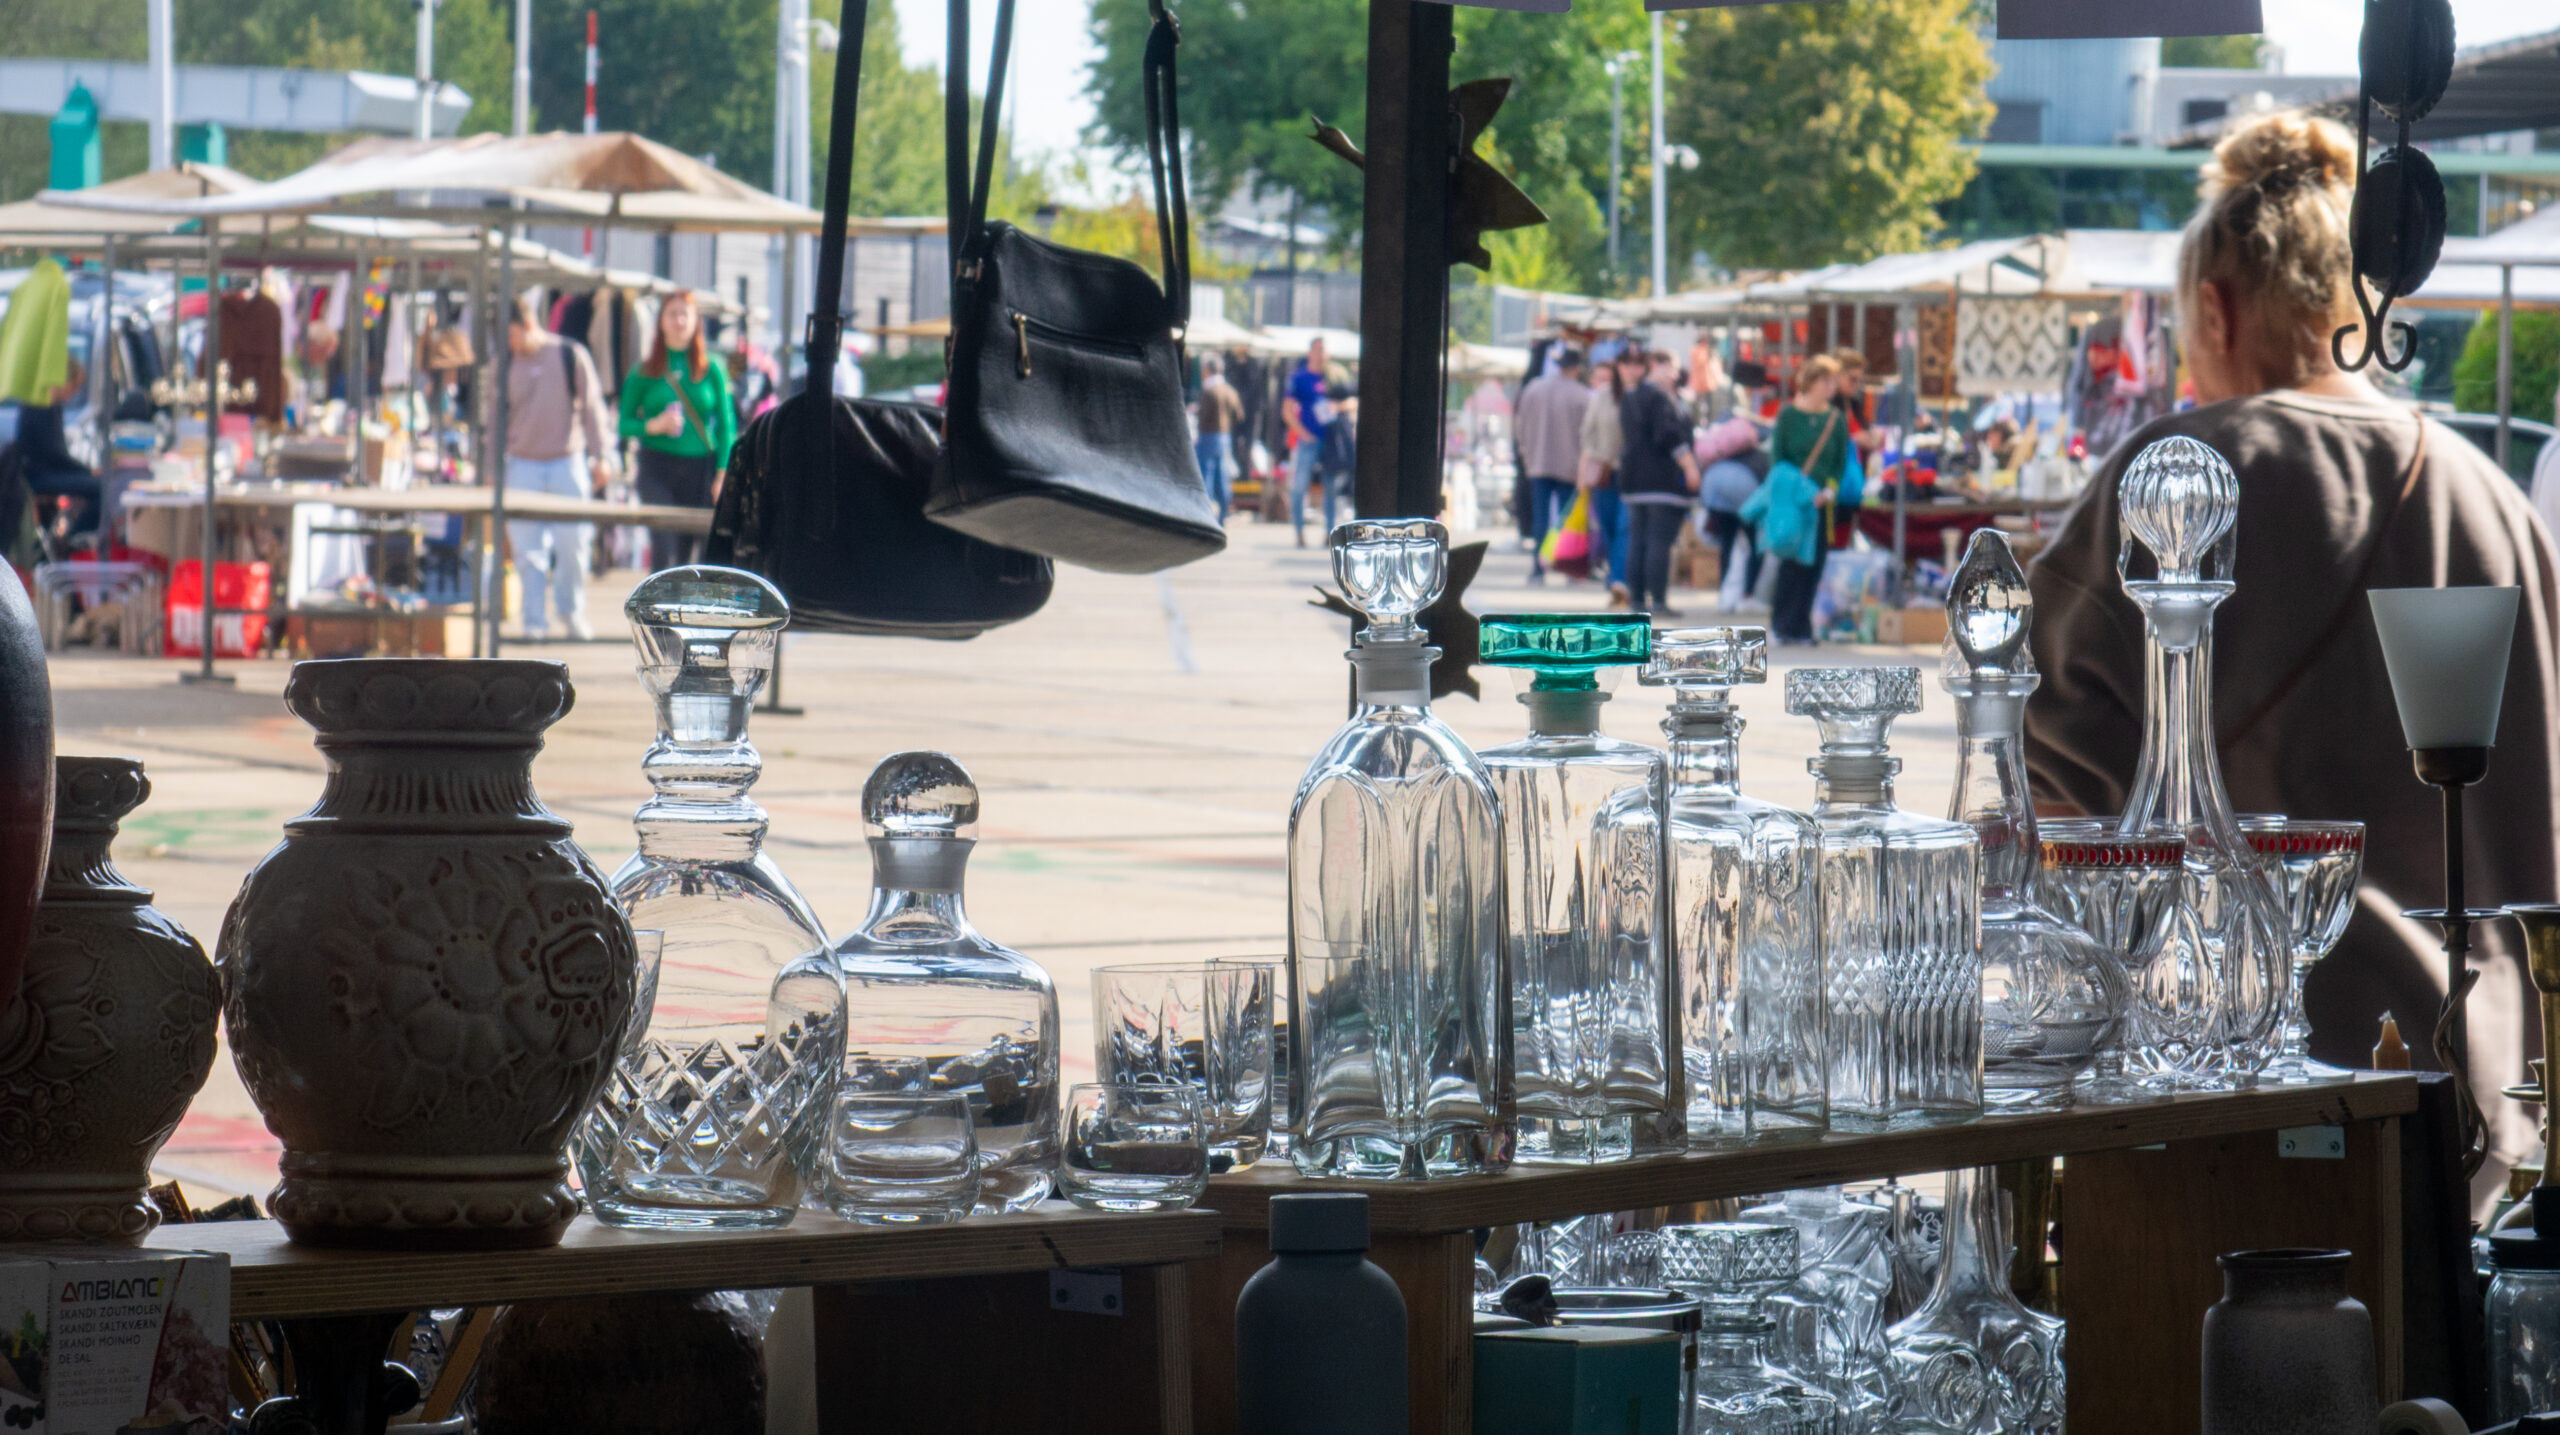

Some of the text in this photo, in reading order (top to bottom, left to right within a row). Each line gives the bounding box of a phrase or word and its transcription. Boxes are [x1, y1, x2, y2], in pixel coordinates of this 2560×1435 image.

[59, 1303, 162, 1320] SKANDI ZOUTMOLEN
[59, 1319, 157, 1335] SKANDI SALTKVÆRN
[58, 1334, 141, 1350] SKANDI MOINHO
[58, 1352, 92, 1364] DE SAL
